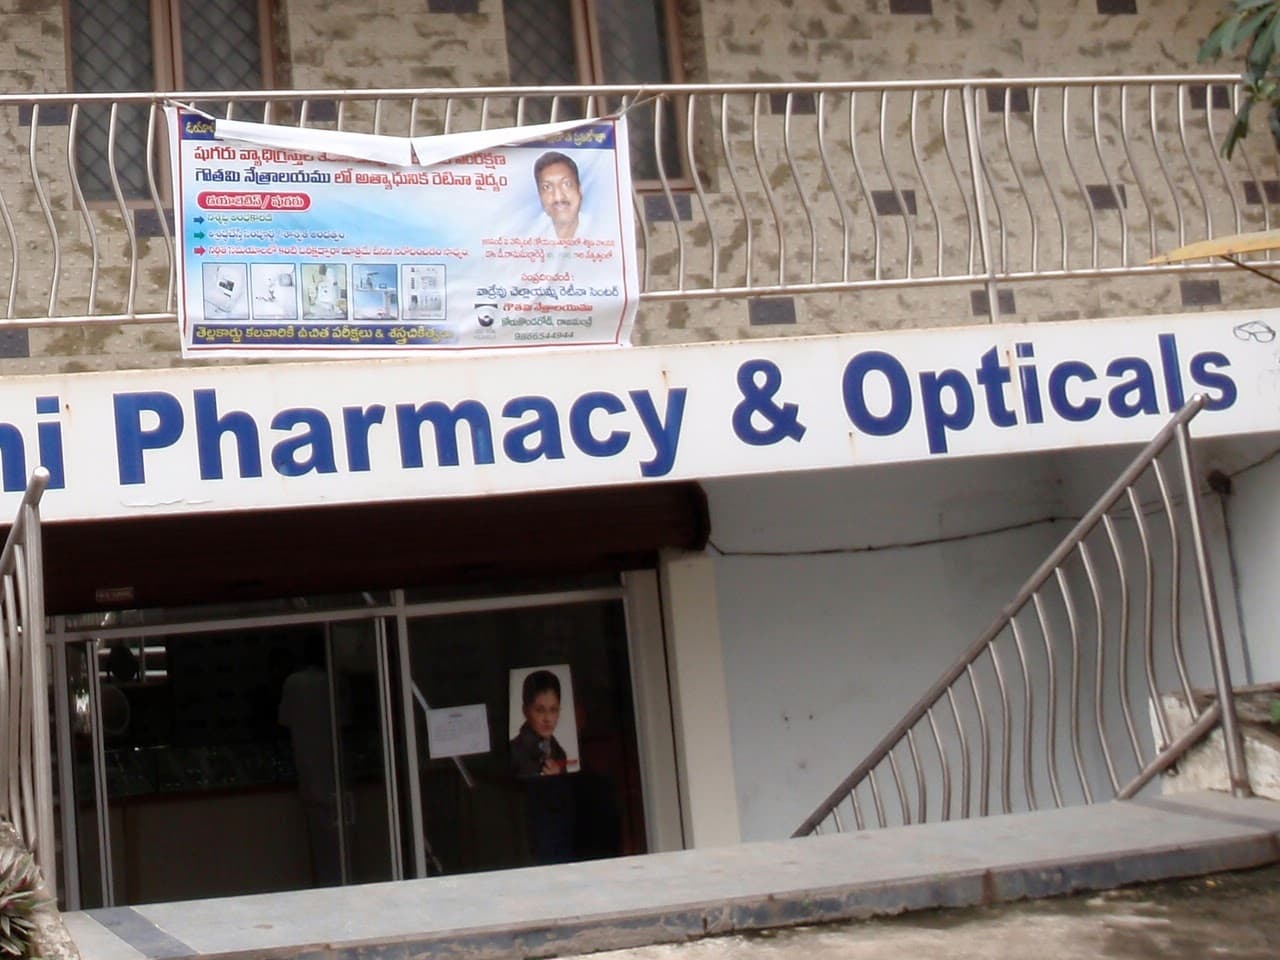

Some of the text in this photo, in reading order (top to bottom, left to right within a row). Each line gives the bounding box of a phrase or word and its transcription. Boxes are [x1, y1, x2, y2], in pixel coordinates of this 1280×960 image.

[194, 145, 236, 161] షుగరు
[334, 168, 353, 183] లో
[475, 172, 508, 192] వైద్యం
[113, 387, 688, 485] Pharmacy
[731, 358, 807, 446] &
[842, 333, 1238, 454] Opticals
